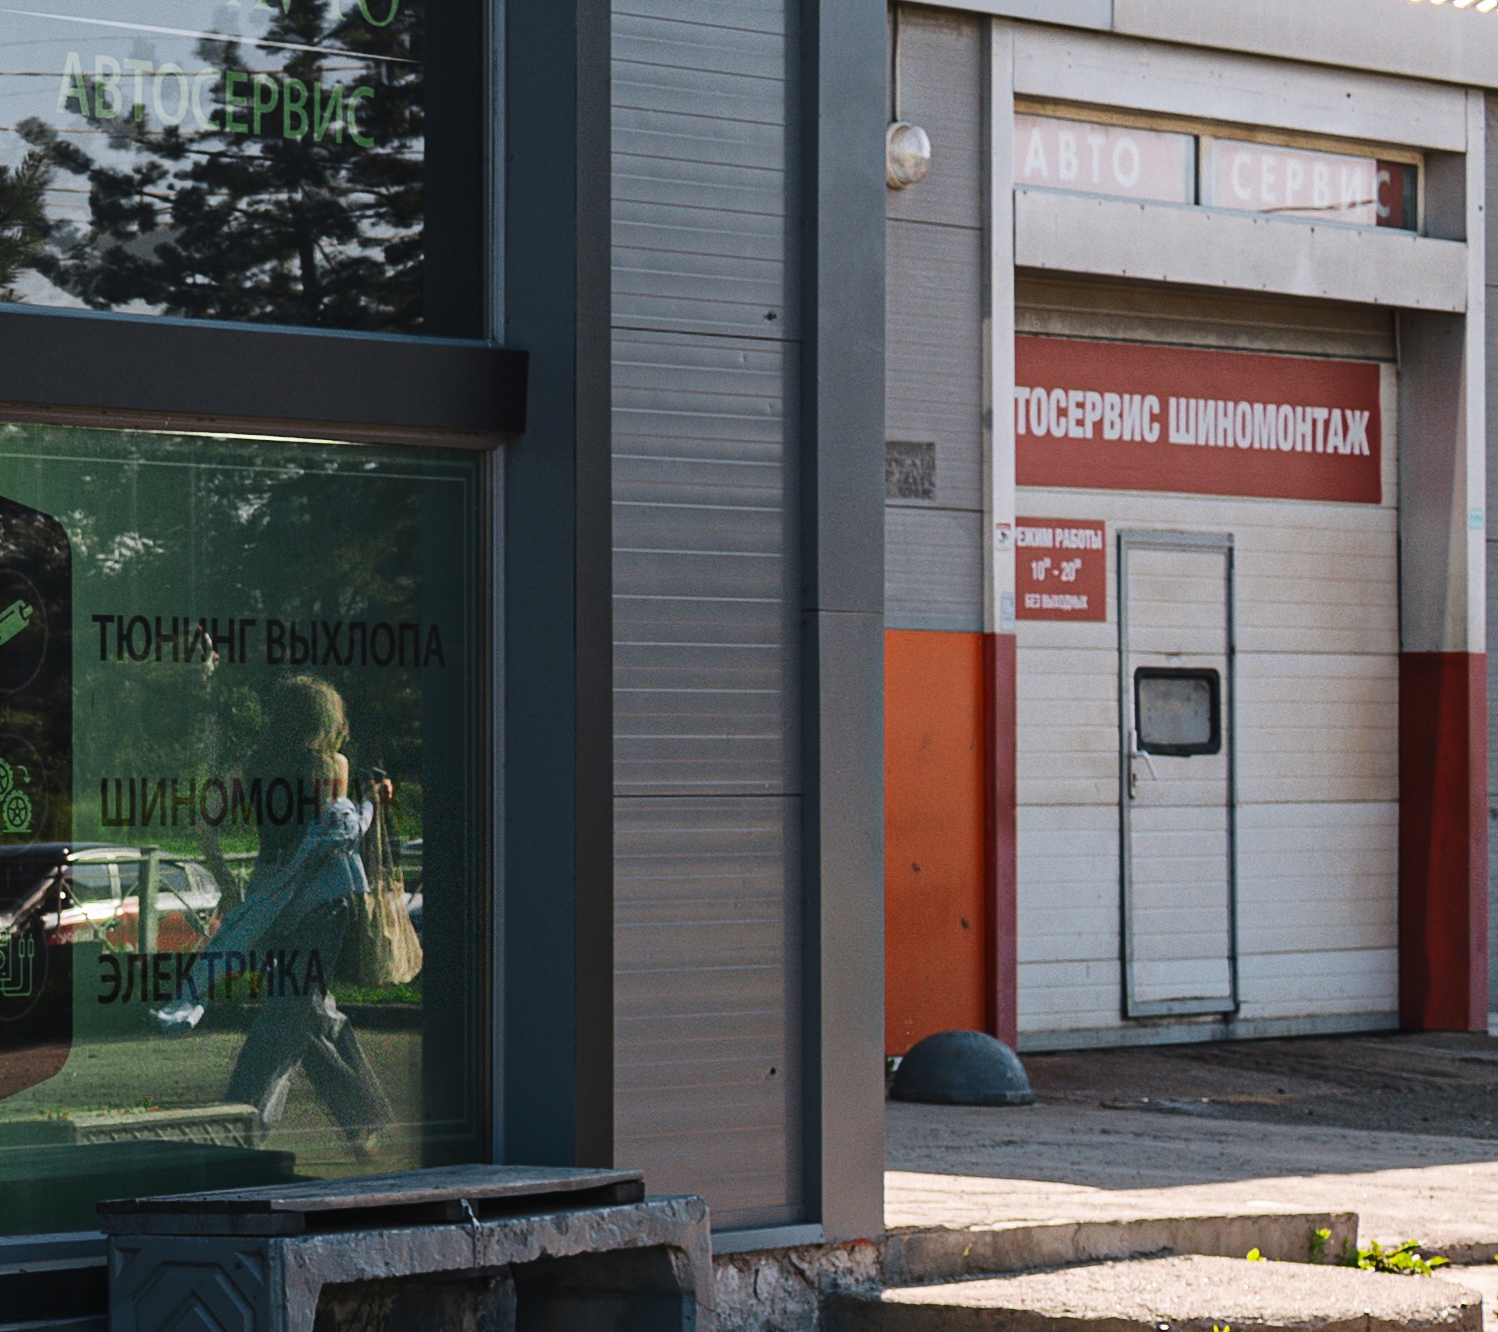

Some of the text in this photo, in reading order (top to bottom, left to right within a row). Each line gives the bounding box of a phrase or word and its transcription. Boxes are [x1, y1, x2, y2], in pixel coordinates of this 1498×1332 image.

[57, 52, 375, 148] АВТОСЕРВИС
[1023, 129, 1392, 218] АВТО СЕРВИС
[1168, 397, 1371, 456] ШИНОМОНТАЖ
[1055, 528, 1103, 550] РАБОТЫ
[92, 614, 446, 668] ТЮНИНГ ВЫХЛОПА
[98, 949, 327, 1005] ЭЛЕКТРИКА
